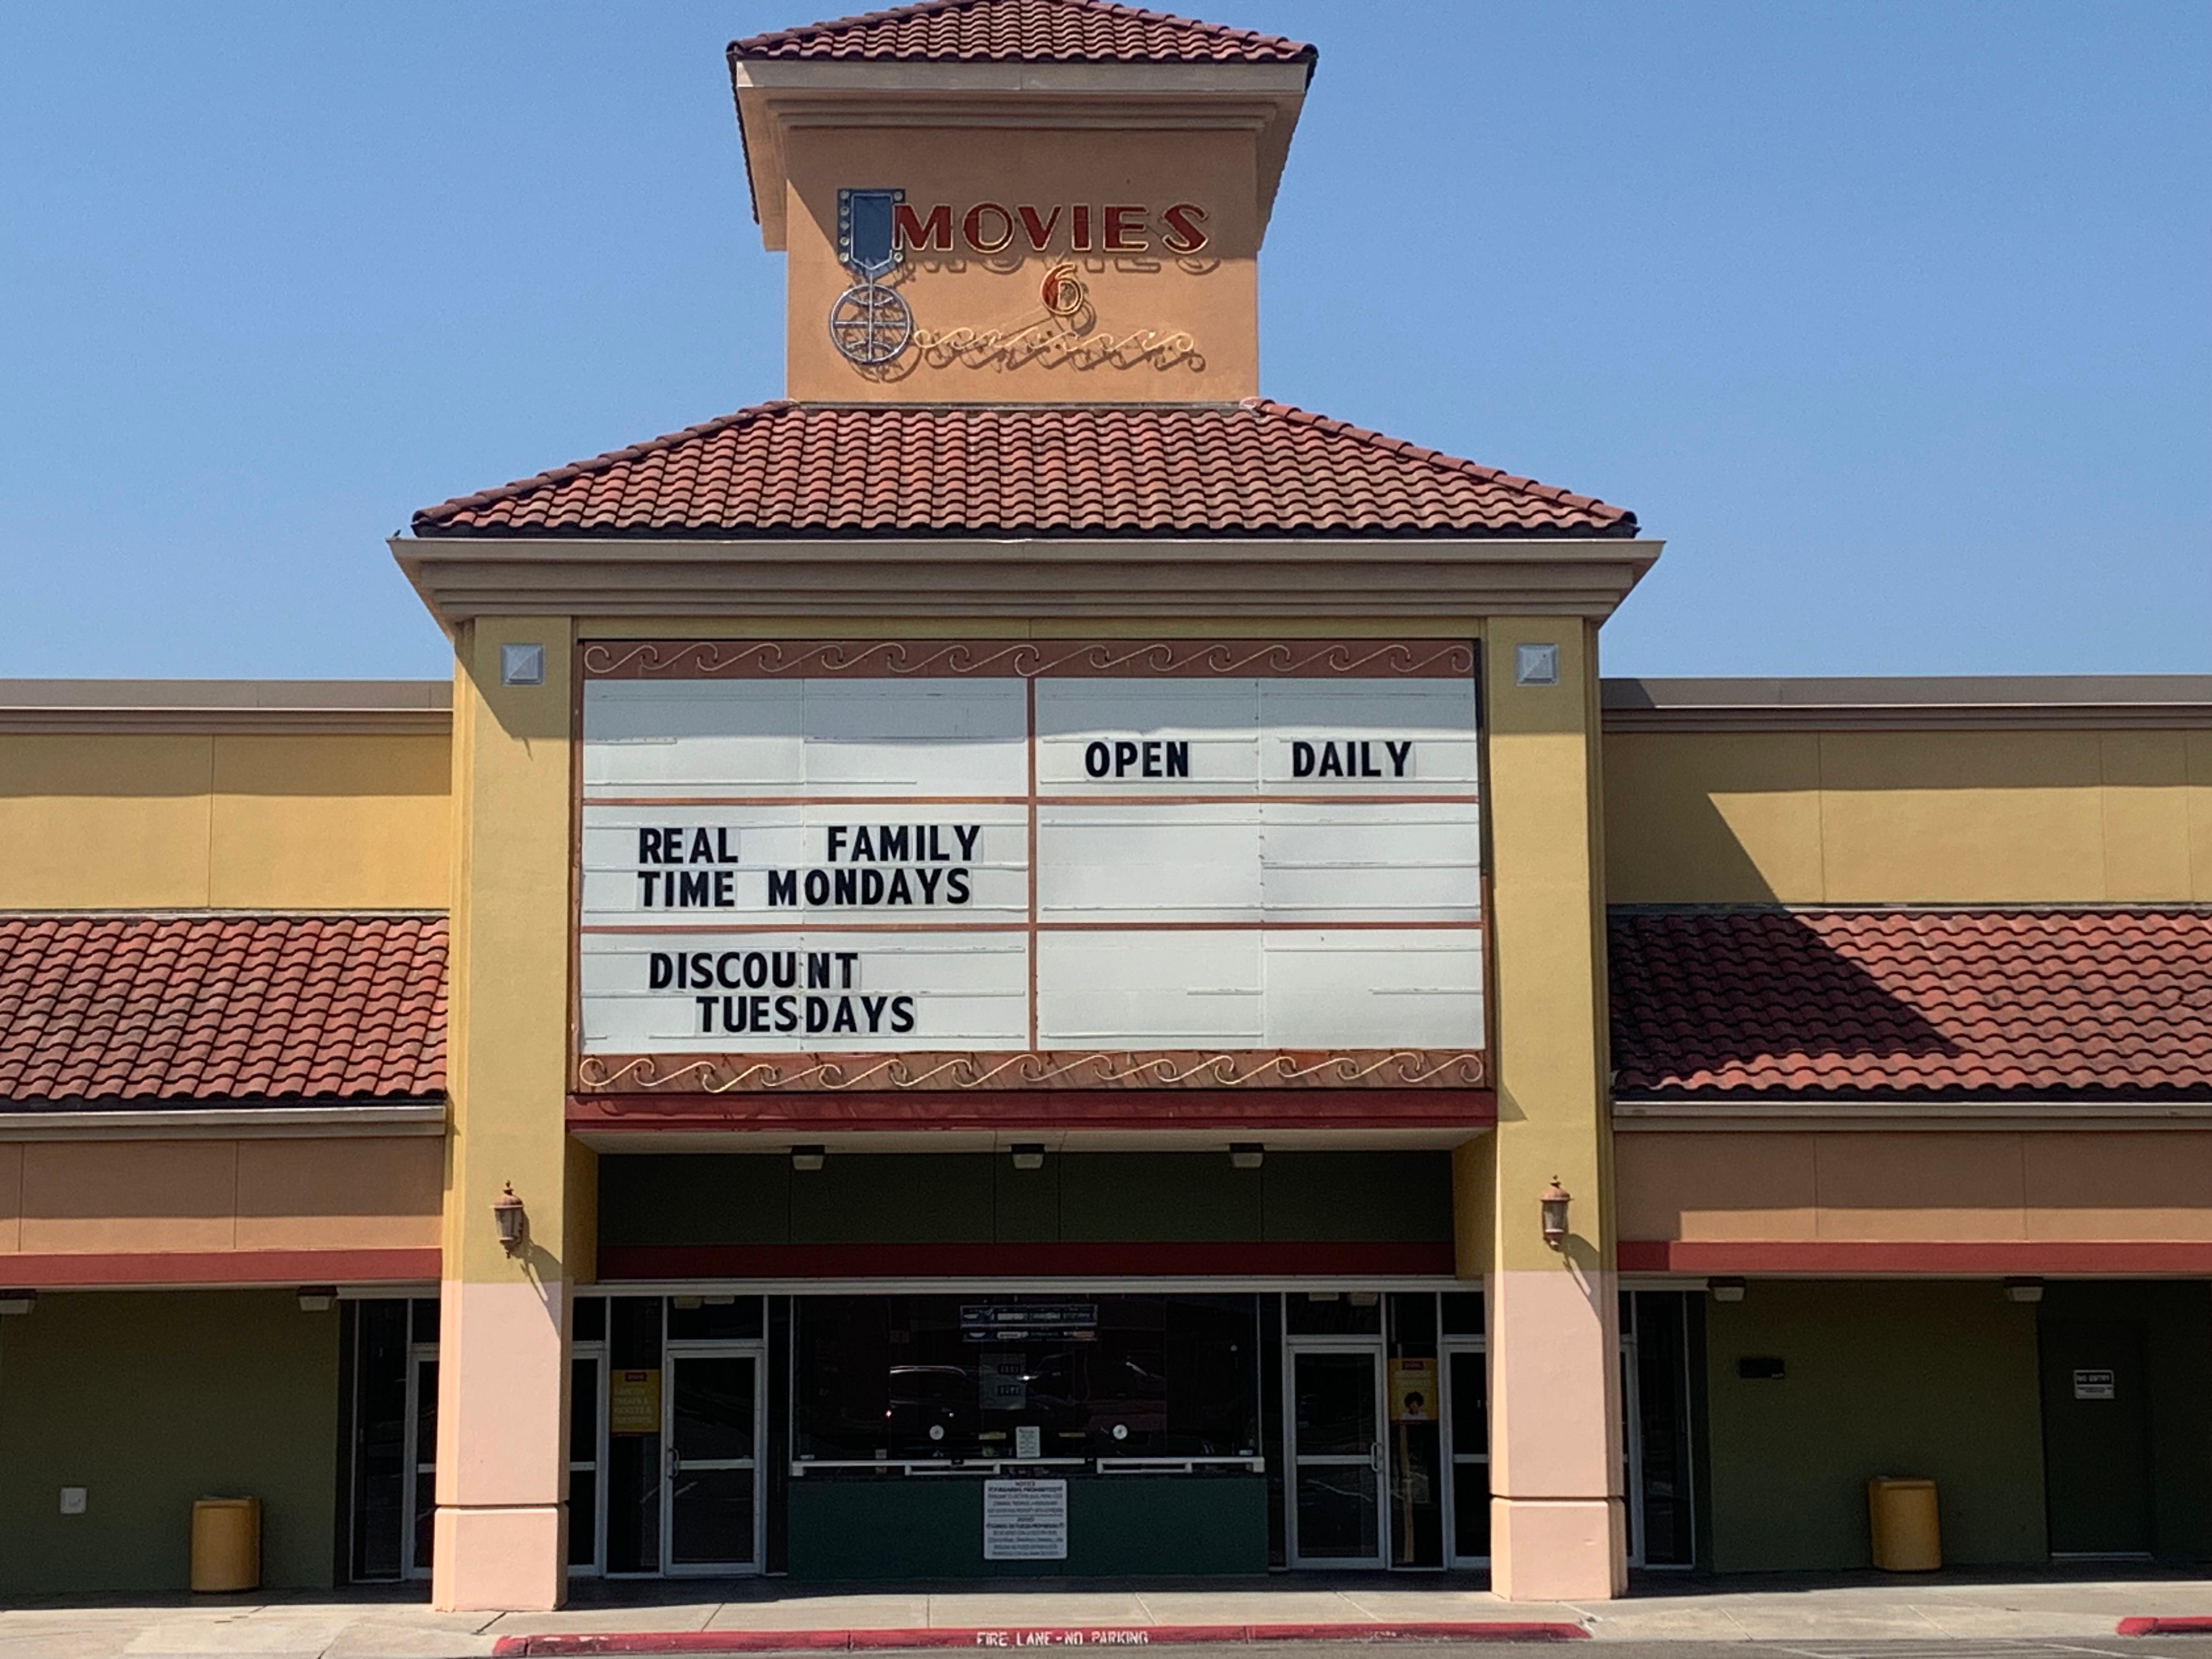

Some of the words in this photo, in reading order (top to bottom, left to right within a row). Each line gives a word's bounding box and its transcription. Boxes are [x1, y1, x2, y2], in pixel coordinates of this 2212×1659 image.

[891, 202, 1208, 254] MOVIES
[1041, 263, 1083, 316] 6
[1085, 741, 1188, 777] OPEN
[1293, 741, 1412, 777] DAILY
[639, 827, 738, 864] REAL
[828, 825, 980, 862] FAMILY
[637, 871, 735, 907] TIME
[768, 867, 970, 906] MONDAYS
[650, 951, 858, 989] DISCOUNT
[696, 995, 914, 1033] TUESDAYS
[977, 1631, 1008, 1646] FIRE
[1091, 1630, 1148, 1645] PARKING
